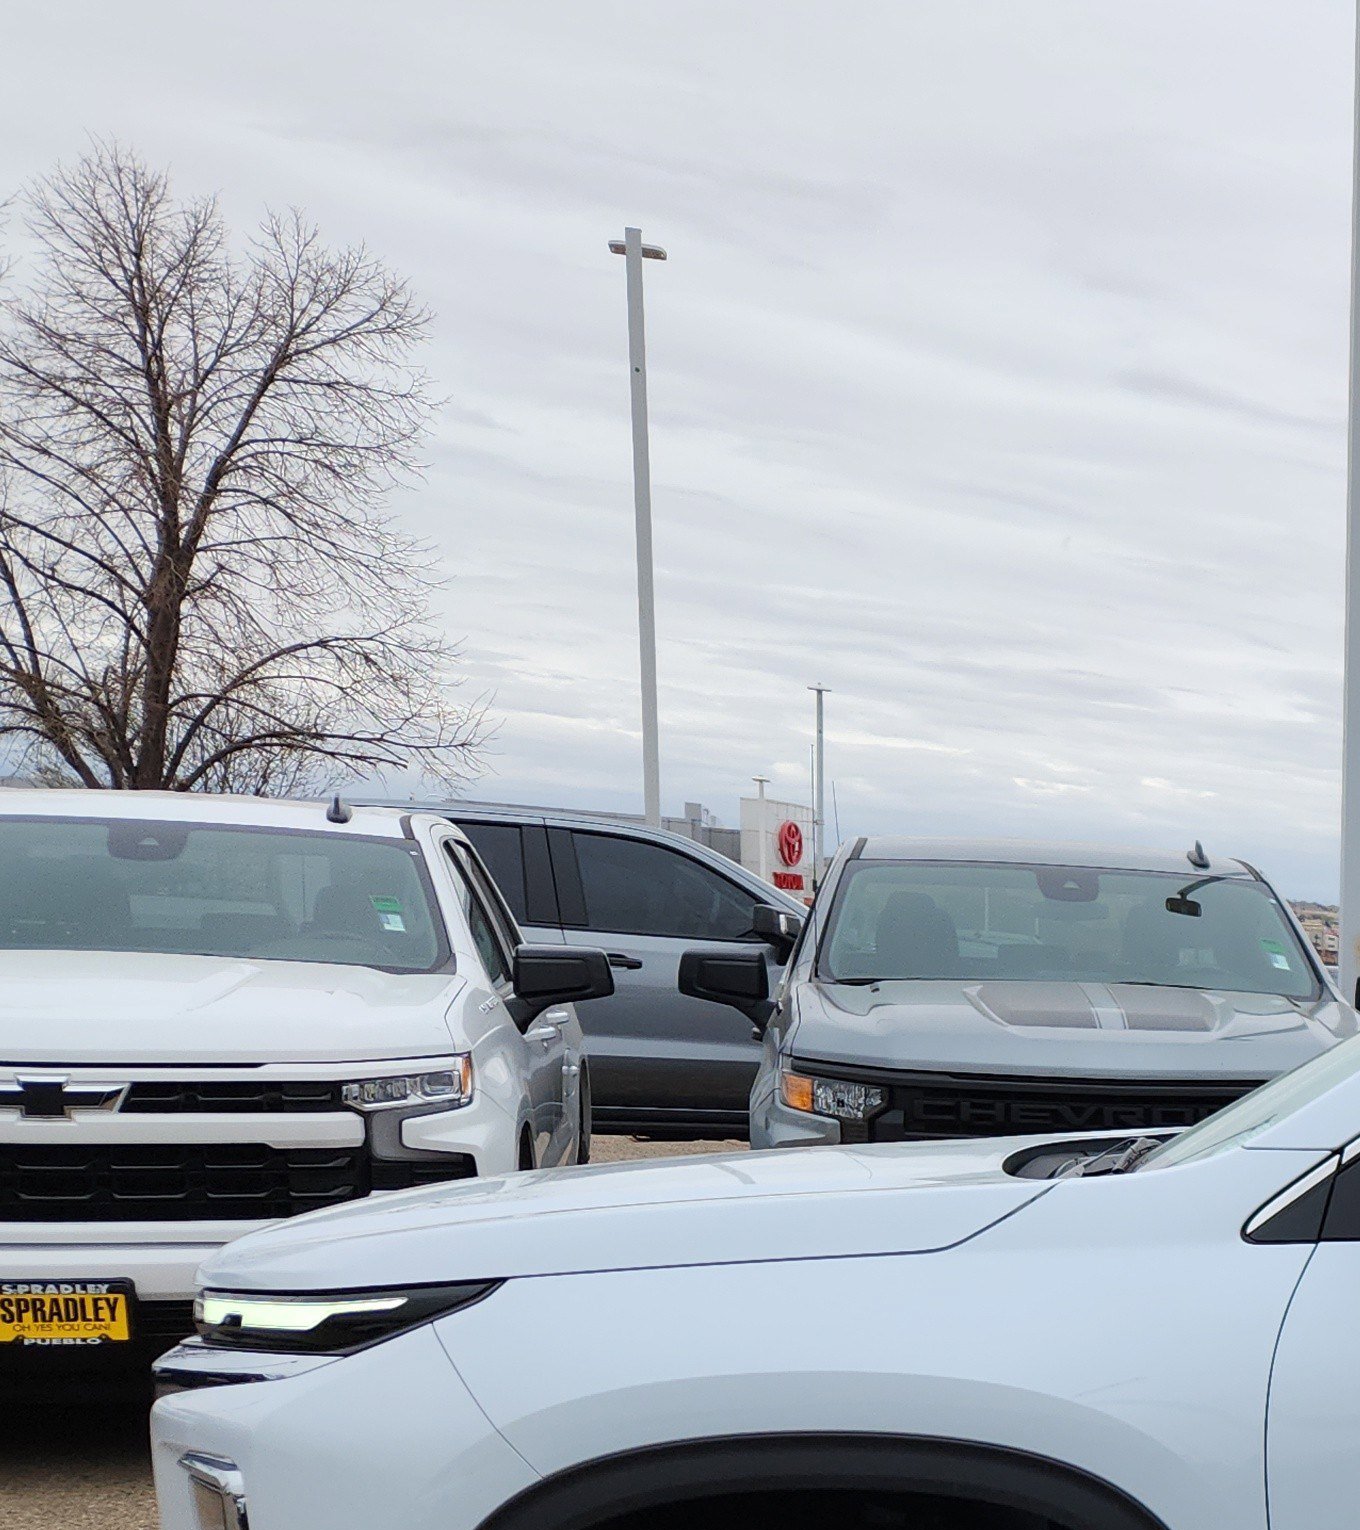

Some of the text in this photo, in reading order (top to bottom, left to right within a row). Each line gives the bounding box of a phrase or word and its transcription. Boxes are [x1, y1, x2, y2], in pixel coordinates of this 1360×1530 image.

[1, 1283, 110, 1295] SPRADLEY
[0, 1297, 119, 1324] SPRADLEY
[12, 1324, 31, 1332] OH
[34, 1323, 52, 1332] YES
[57, 1323, 80, 1332] YOU
[23, 1337, 103, 1346] PUEBLO
